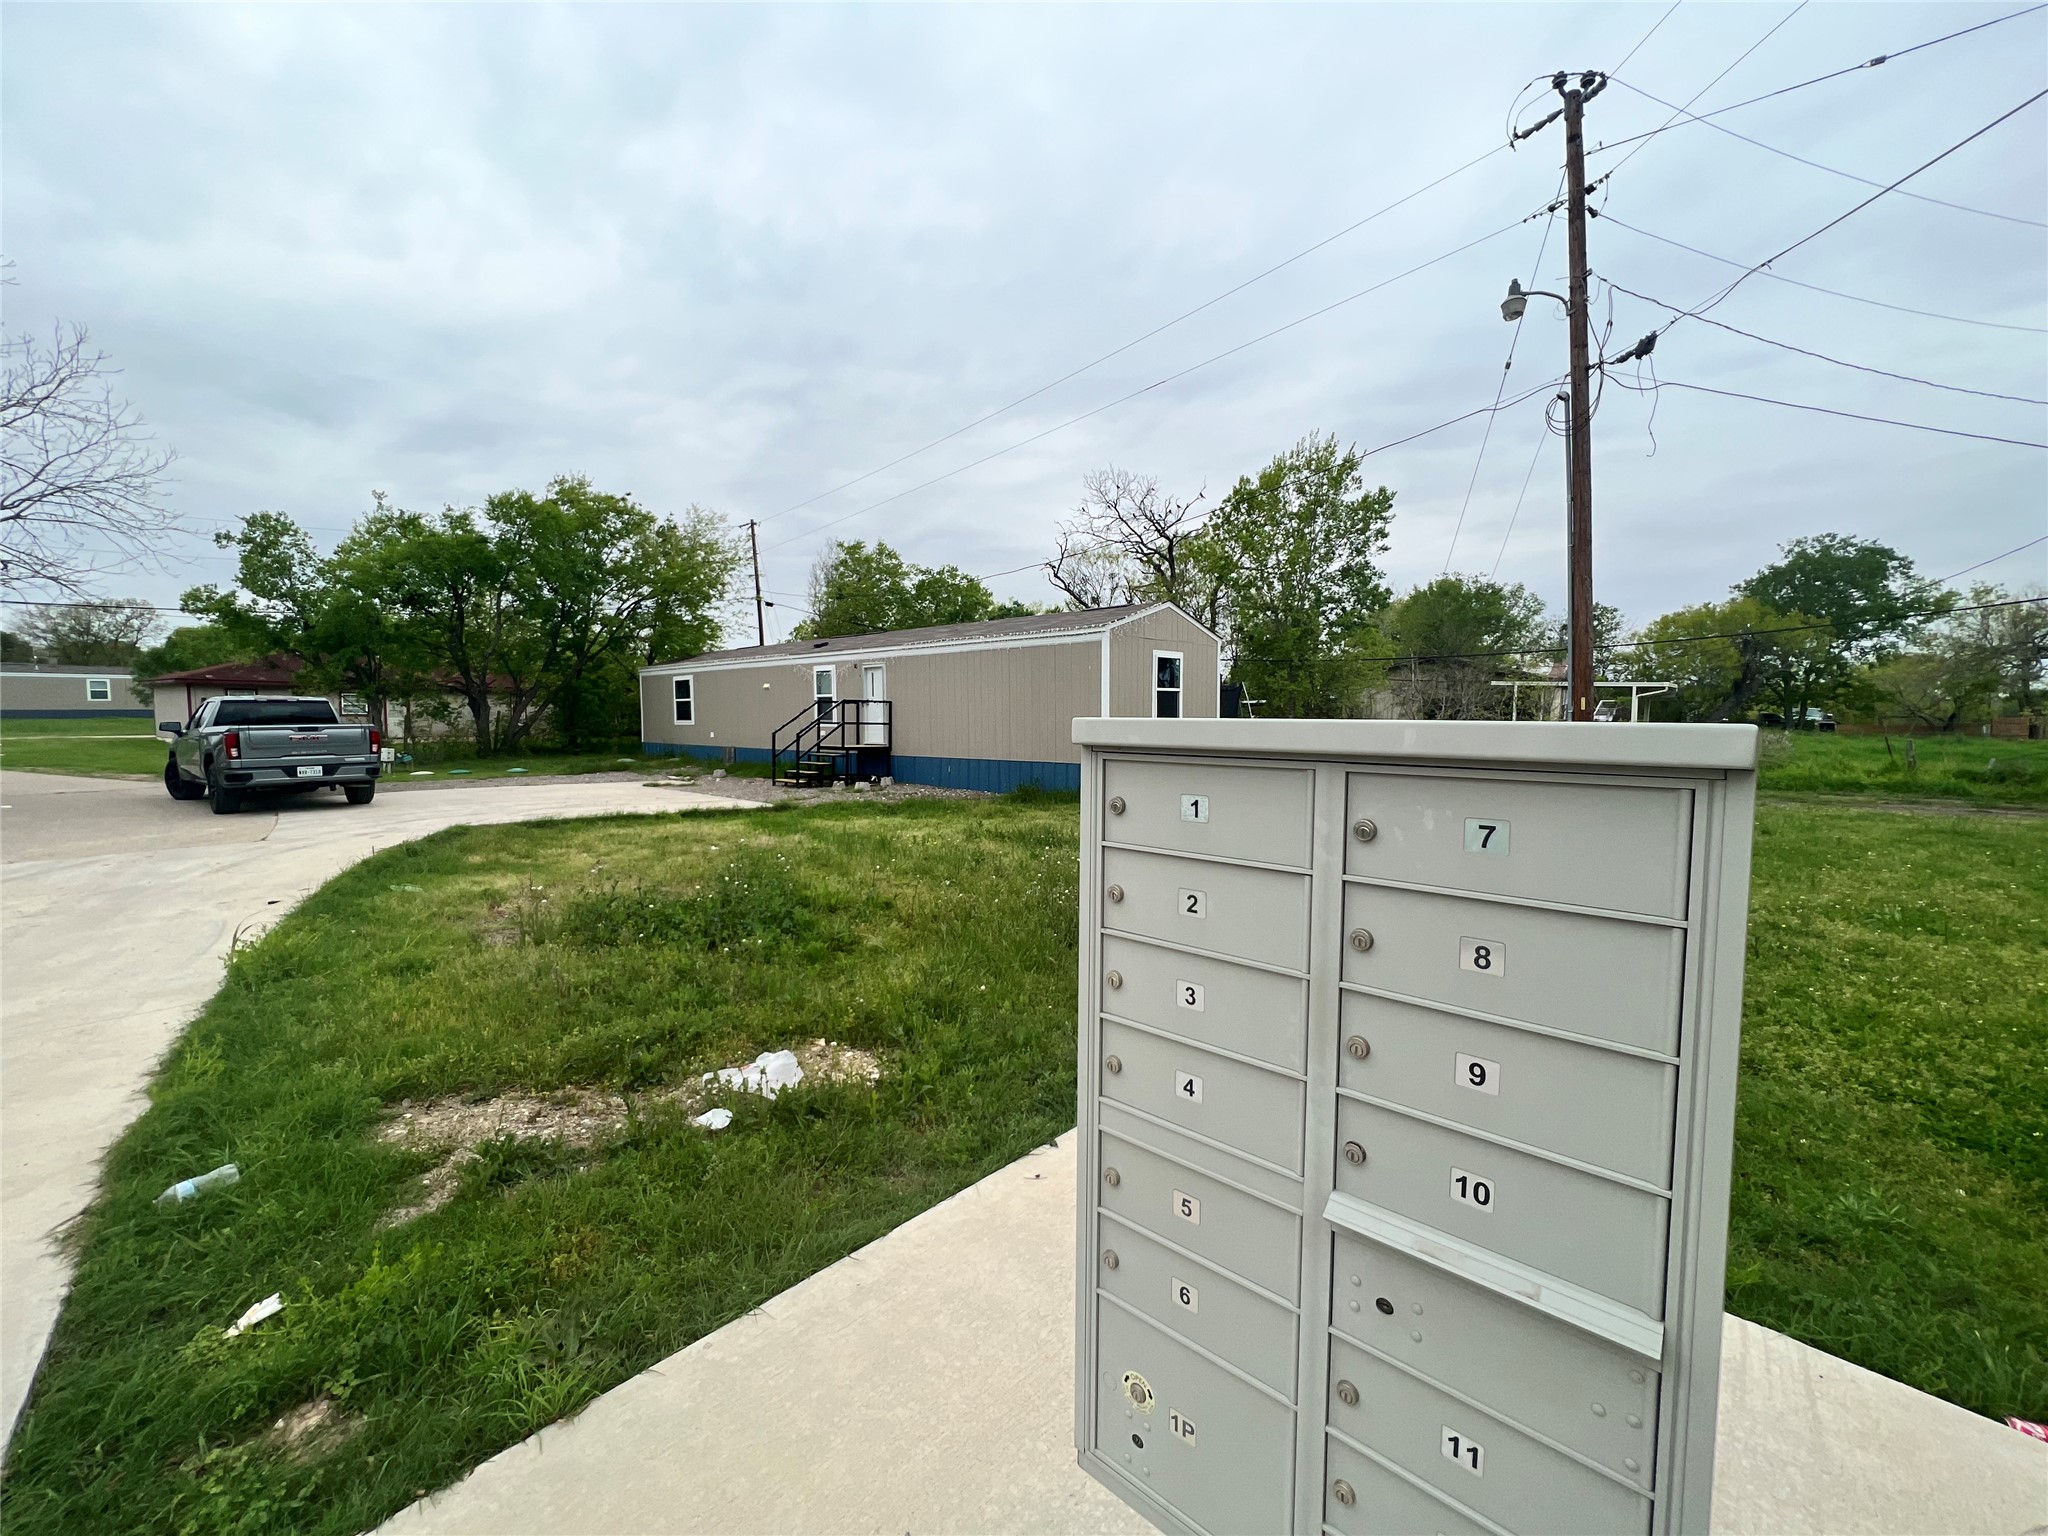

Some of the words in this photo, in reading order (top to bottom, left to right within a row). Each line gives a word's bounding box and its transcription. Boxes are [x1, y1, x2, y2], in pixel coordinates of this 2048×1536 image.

[1190, 799, 1199, 819] 1
[1478, 824, 1497, 849] 7
[1186, 894, 1198, 914] 2
[1473, 945, 1492, 970] 8
[1184, 986, 1196, 1006] 3
[1468, 1062, 1487, 1087] 9
[1183, 1078, 1195, 1098] 4
[1455, 1175, 1491, 1206] 10
[1181, 1197, 1192, 1217] 5
[1179, 1286, 1191, 1306] 6
[1130, 1373, 1147, 1388] OPEN
[1171, 1414, 1195, 1438] 1P
[1447, 1435, 1479, 1470] 11
